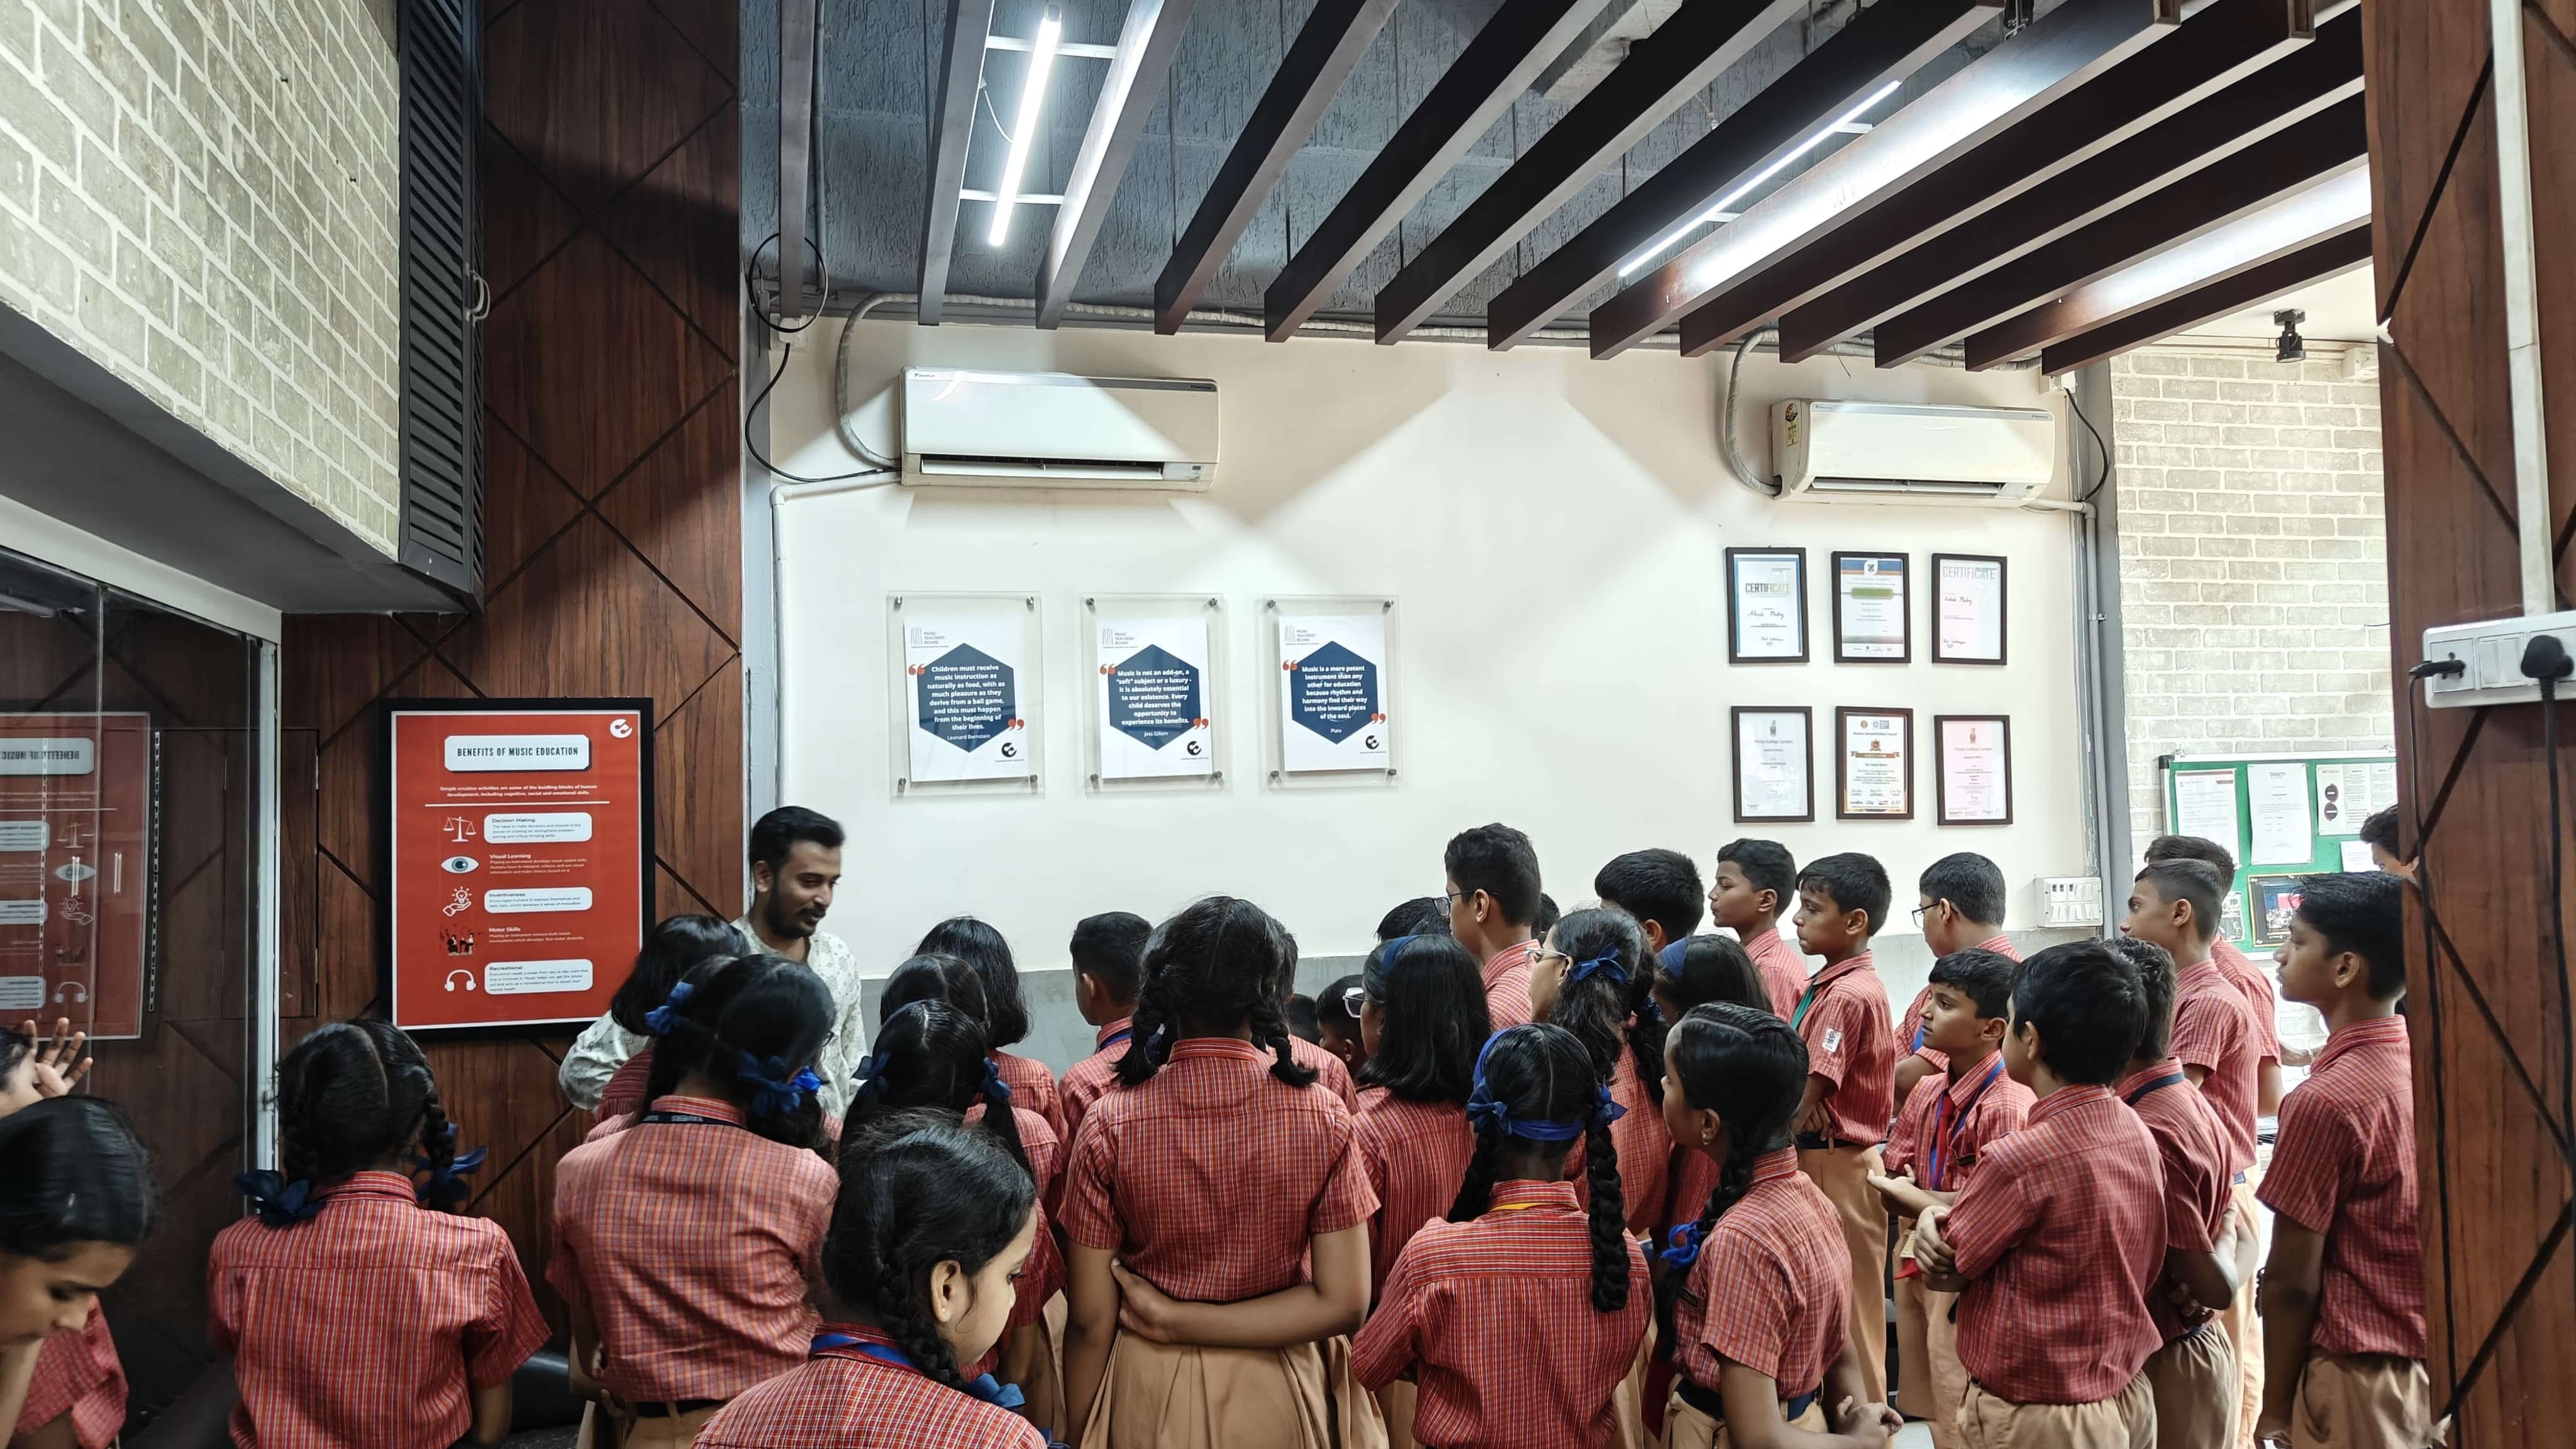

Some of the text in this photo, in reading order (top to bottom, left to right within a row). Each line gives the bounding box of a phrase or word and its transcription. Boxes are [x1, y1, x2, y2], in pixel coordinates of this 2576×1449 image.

[1943, 566, 1996, 579] CERTIFICATE
[1745, 582, 1791, 594] CERTIFICATE
[1134, 677, 1156, 686] subject
[977, 706, 1001, 714] happen
[963, 714, 994, 723] beginning
[457, 747, 578, 757] BENEFITS OF MUSIC EDUCATION
